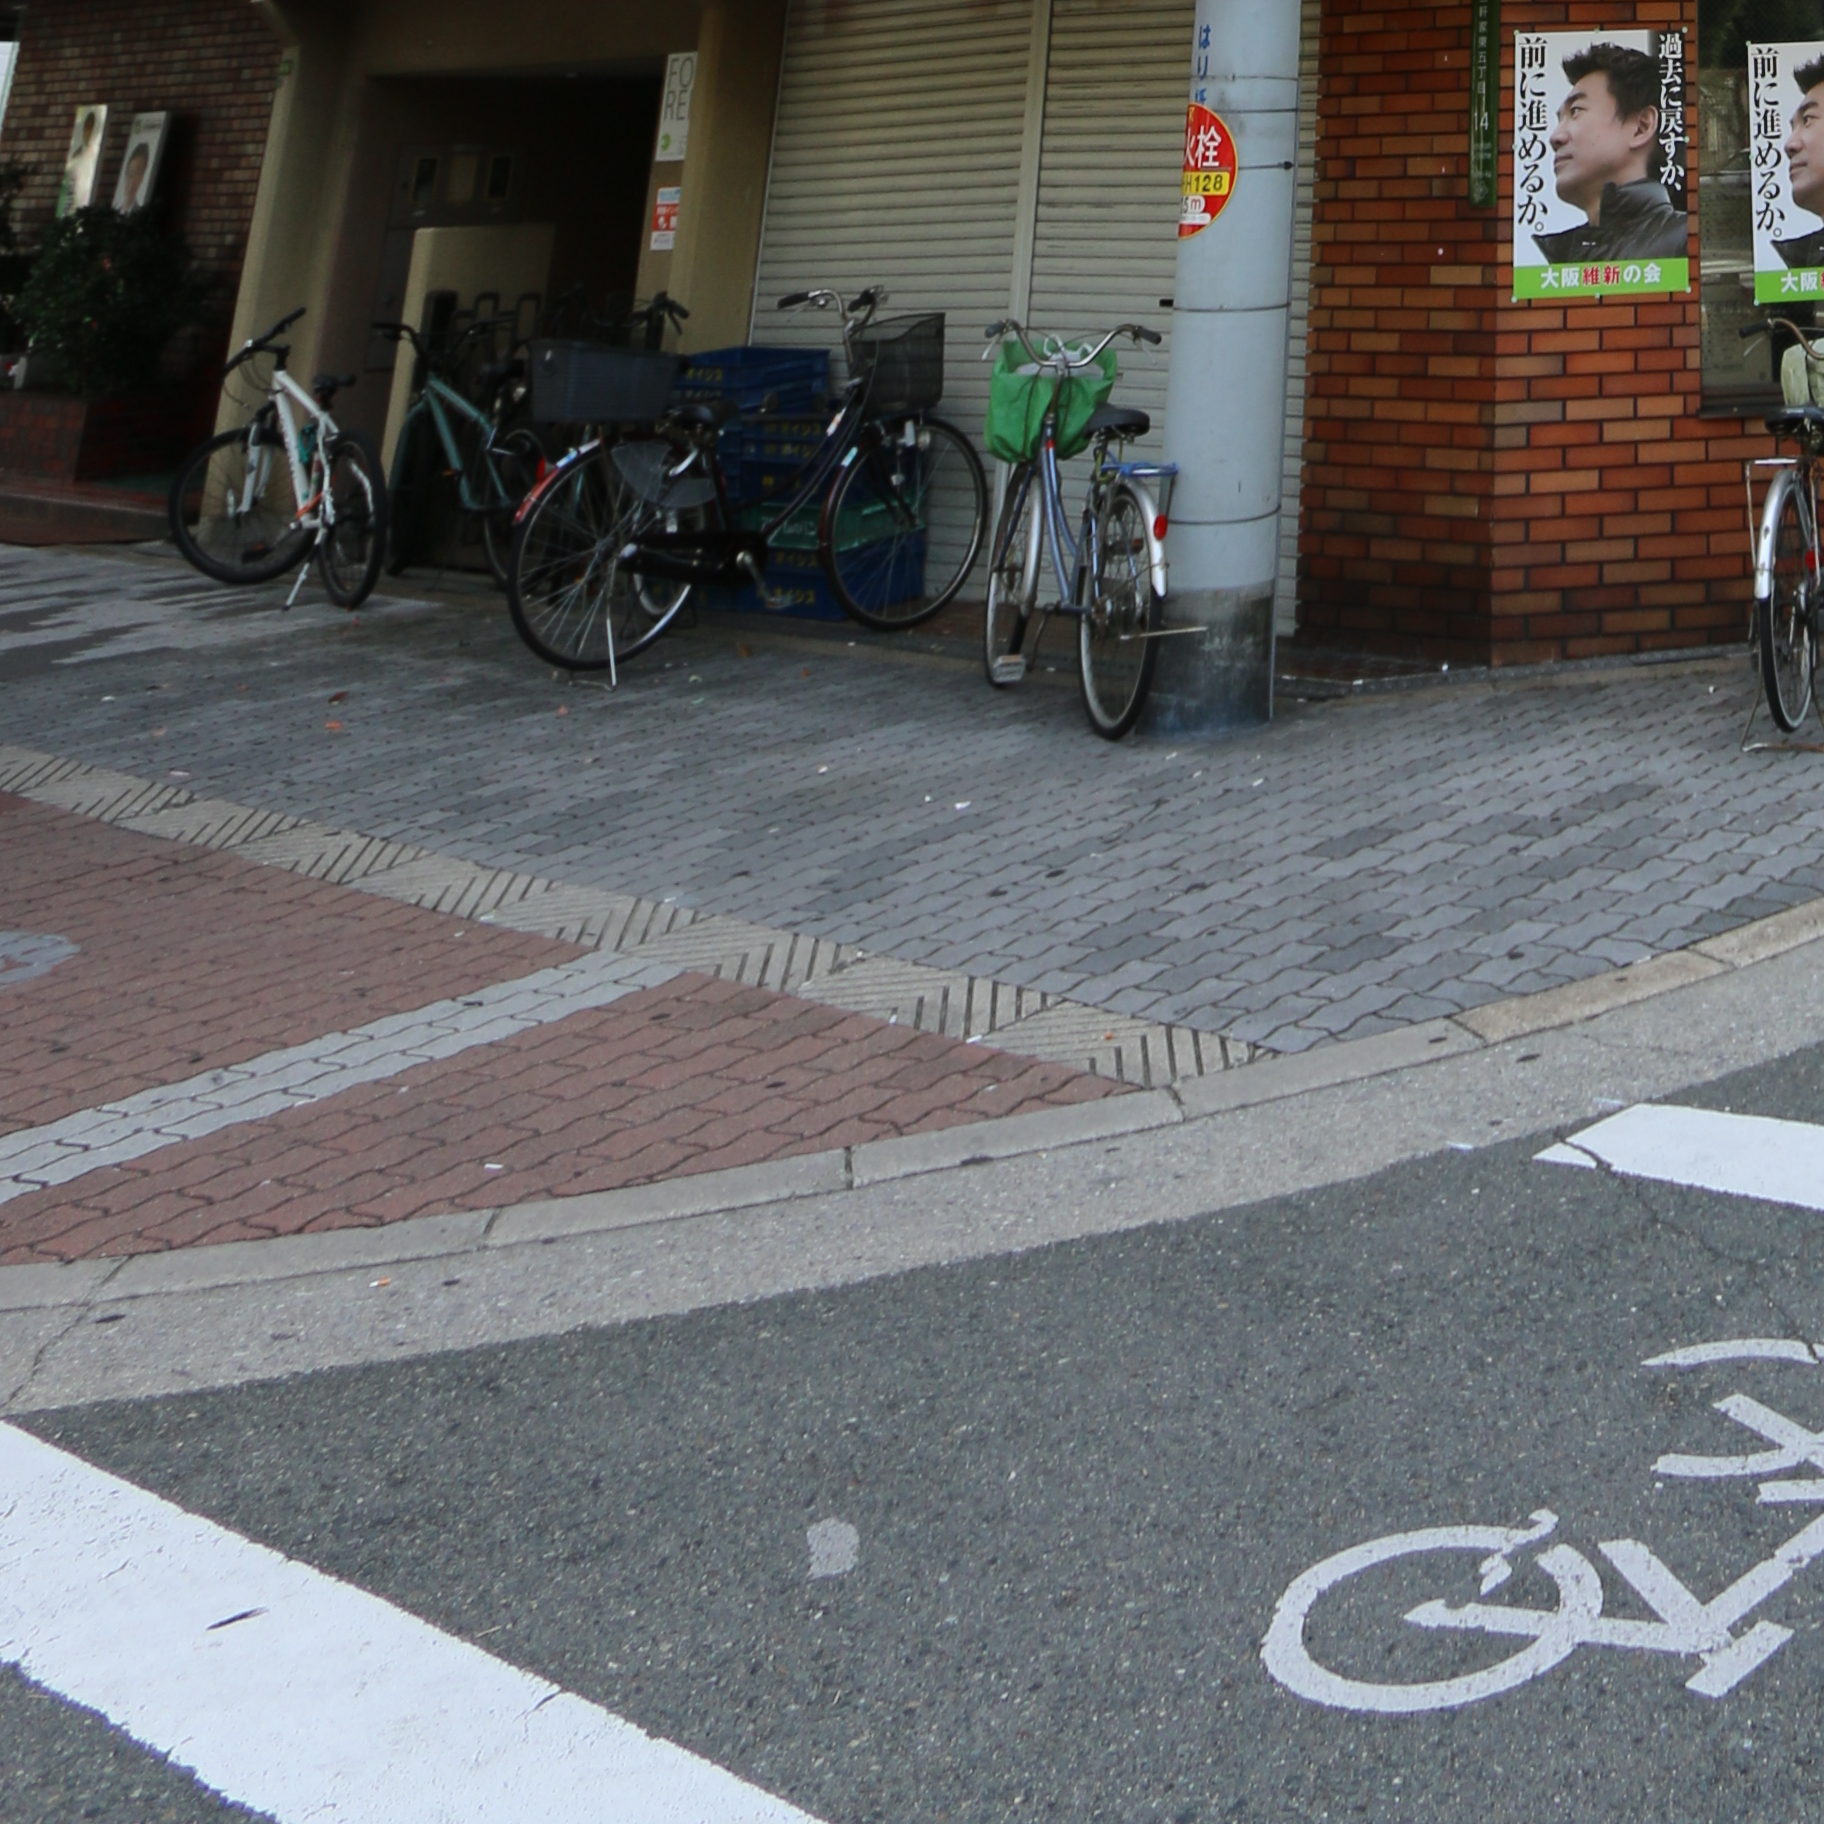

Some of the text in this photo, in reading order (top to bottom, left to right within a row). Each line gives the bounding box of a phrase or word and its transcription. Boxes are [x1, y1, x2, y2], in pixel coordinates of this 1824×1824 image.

[667, 56, 694, 89] FO
[663, 88, 689, 121] RE
[1473, 111, 1489, 131] 14
[1517, 35, 1550, 233] 前に進めるか。
[1750, 46, 1786, 239] 前に進めるか。
[1540, 261, 1663, 289] 大阪維新の会
